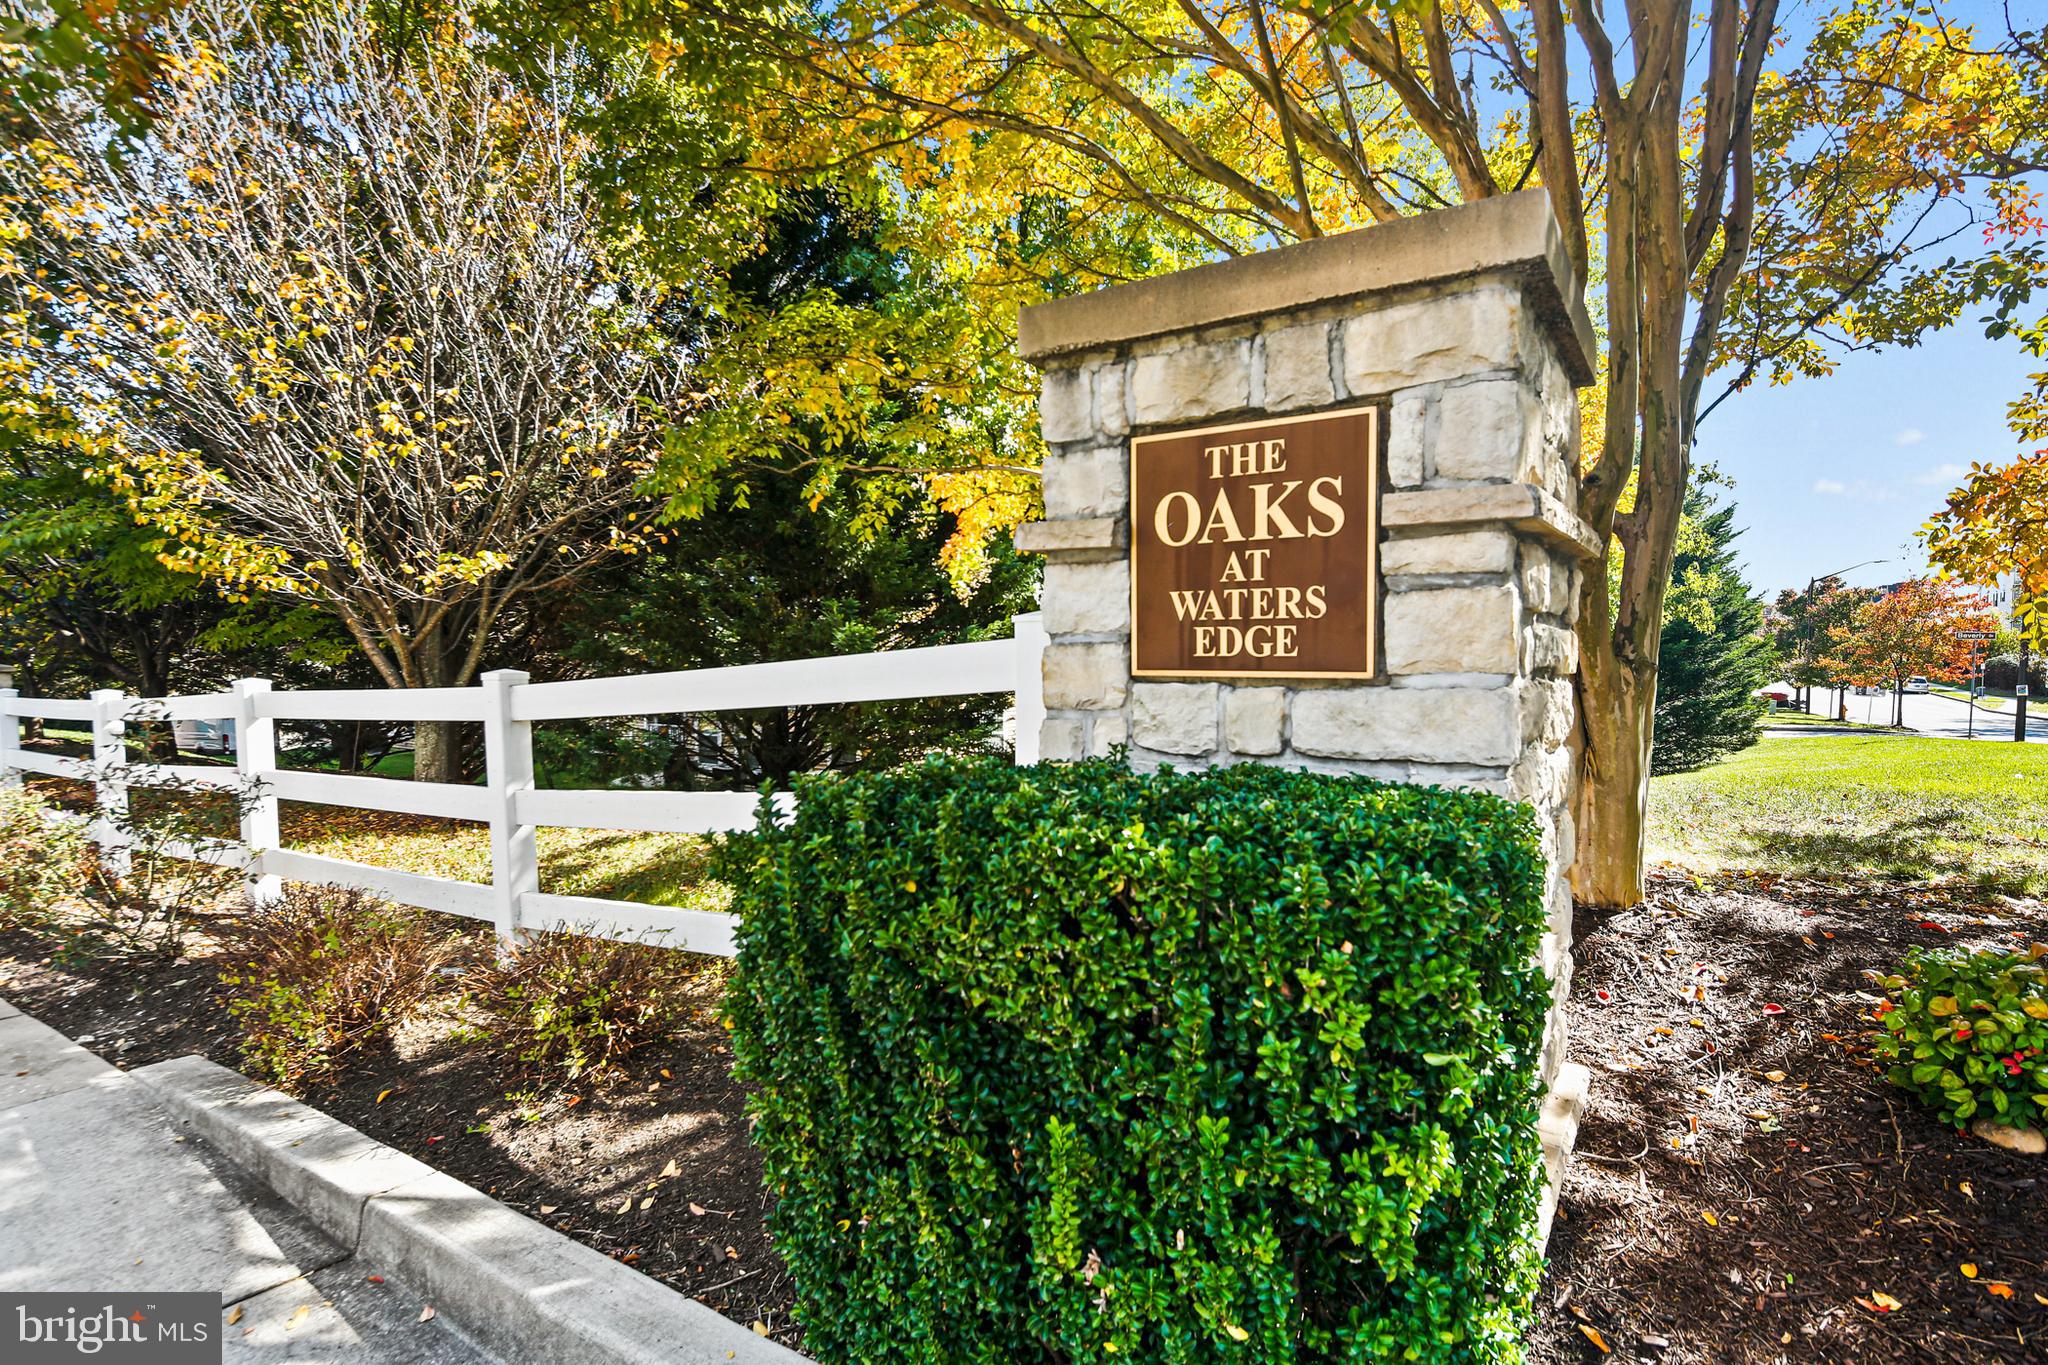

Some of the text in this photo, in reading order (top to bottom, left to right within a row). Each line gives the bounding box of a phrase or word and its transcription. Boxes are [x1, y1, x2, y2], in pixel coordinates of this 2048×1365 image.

[1204, 438, 1287, 479] THE
[1154, 475, 1346, 547] OAKS
[1219, 549, 1271, 583] AT
[1168, 585, 1328, 622] WATERS
[1193, 625, 1299, 658] EDGE
[1957, 632, 1986, 640] Beverly
